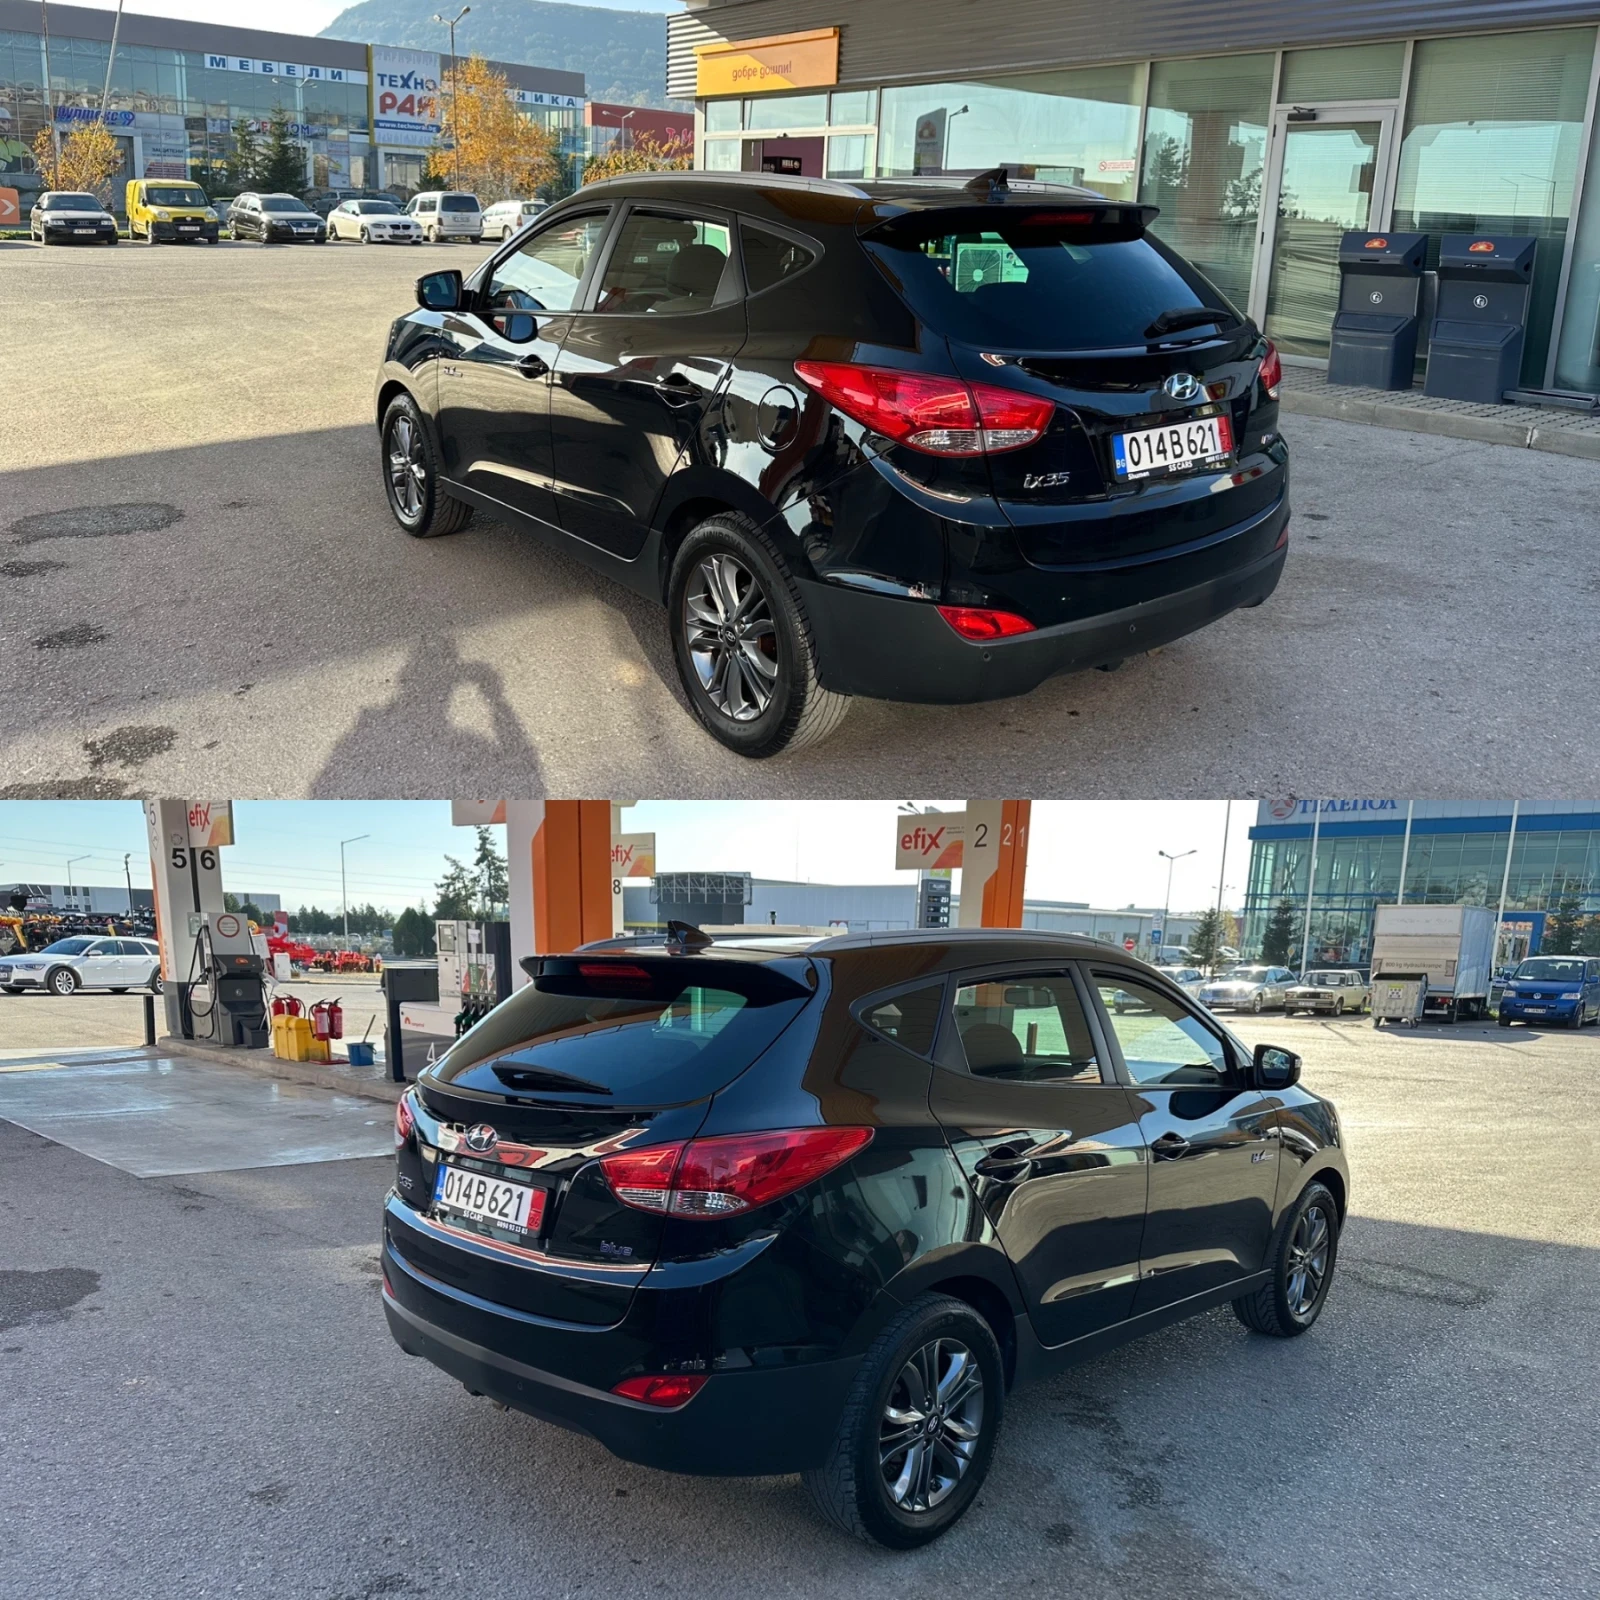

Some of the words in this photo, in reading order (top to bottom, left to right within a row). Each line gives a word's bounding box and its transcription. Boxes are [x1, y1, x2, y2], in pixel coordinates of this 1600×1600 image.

[209, 56, 342, 81] МЕБЕЛИ
[732, 65, 757, 81] добре
[760, 60, 792, 79] дошли!
[377, 70, 437, 91] ТЕХНО
[1115, 459, 1126, 469] BG
[1177, 460, 1193, 470] CARS
[1023, 471, 1070, 488] ix35
[189, 802, 211, 832] efix
[900, 826, 946, 856] efix
[974, 823, 988, 848] 2
[1002, 823, 1012, 846] 2
[1019, 825, 1025, 848] 1
[172, 847, 187, 869] 5
[200, 849, 216, 871] 6
[612, 879, 621, 895] 8
[470, 1212, 484, 1222] CARS
[600, 1240, 632, 1256] blue
